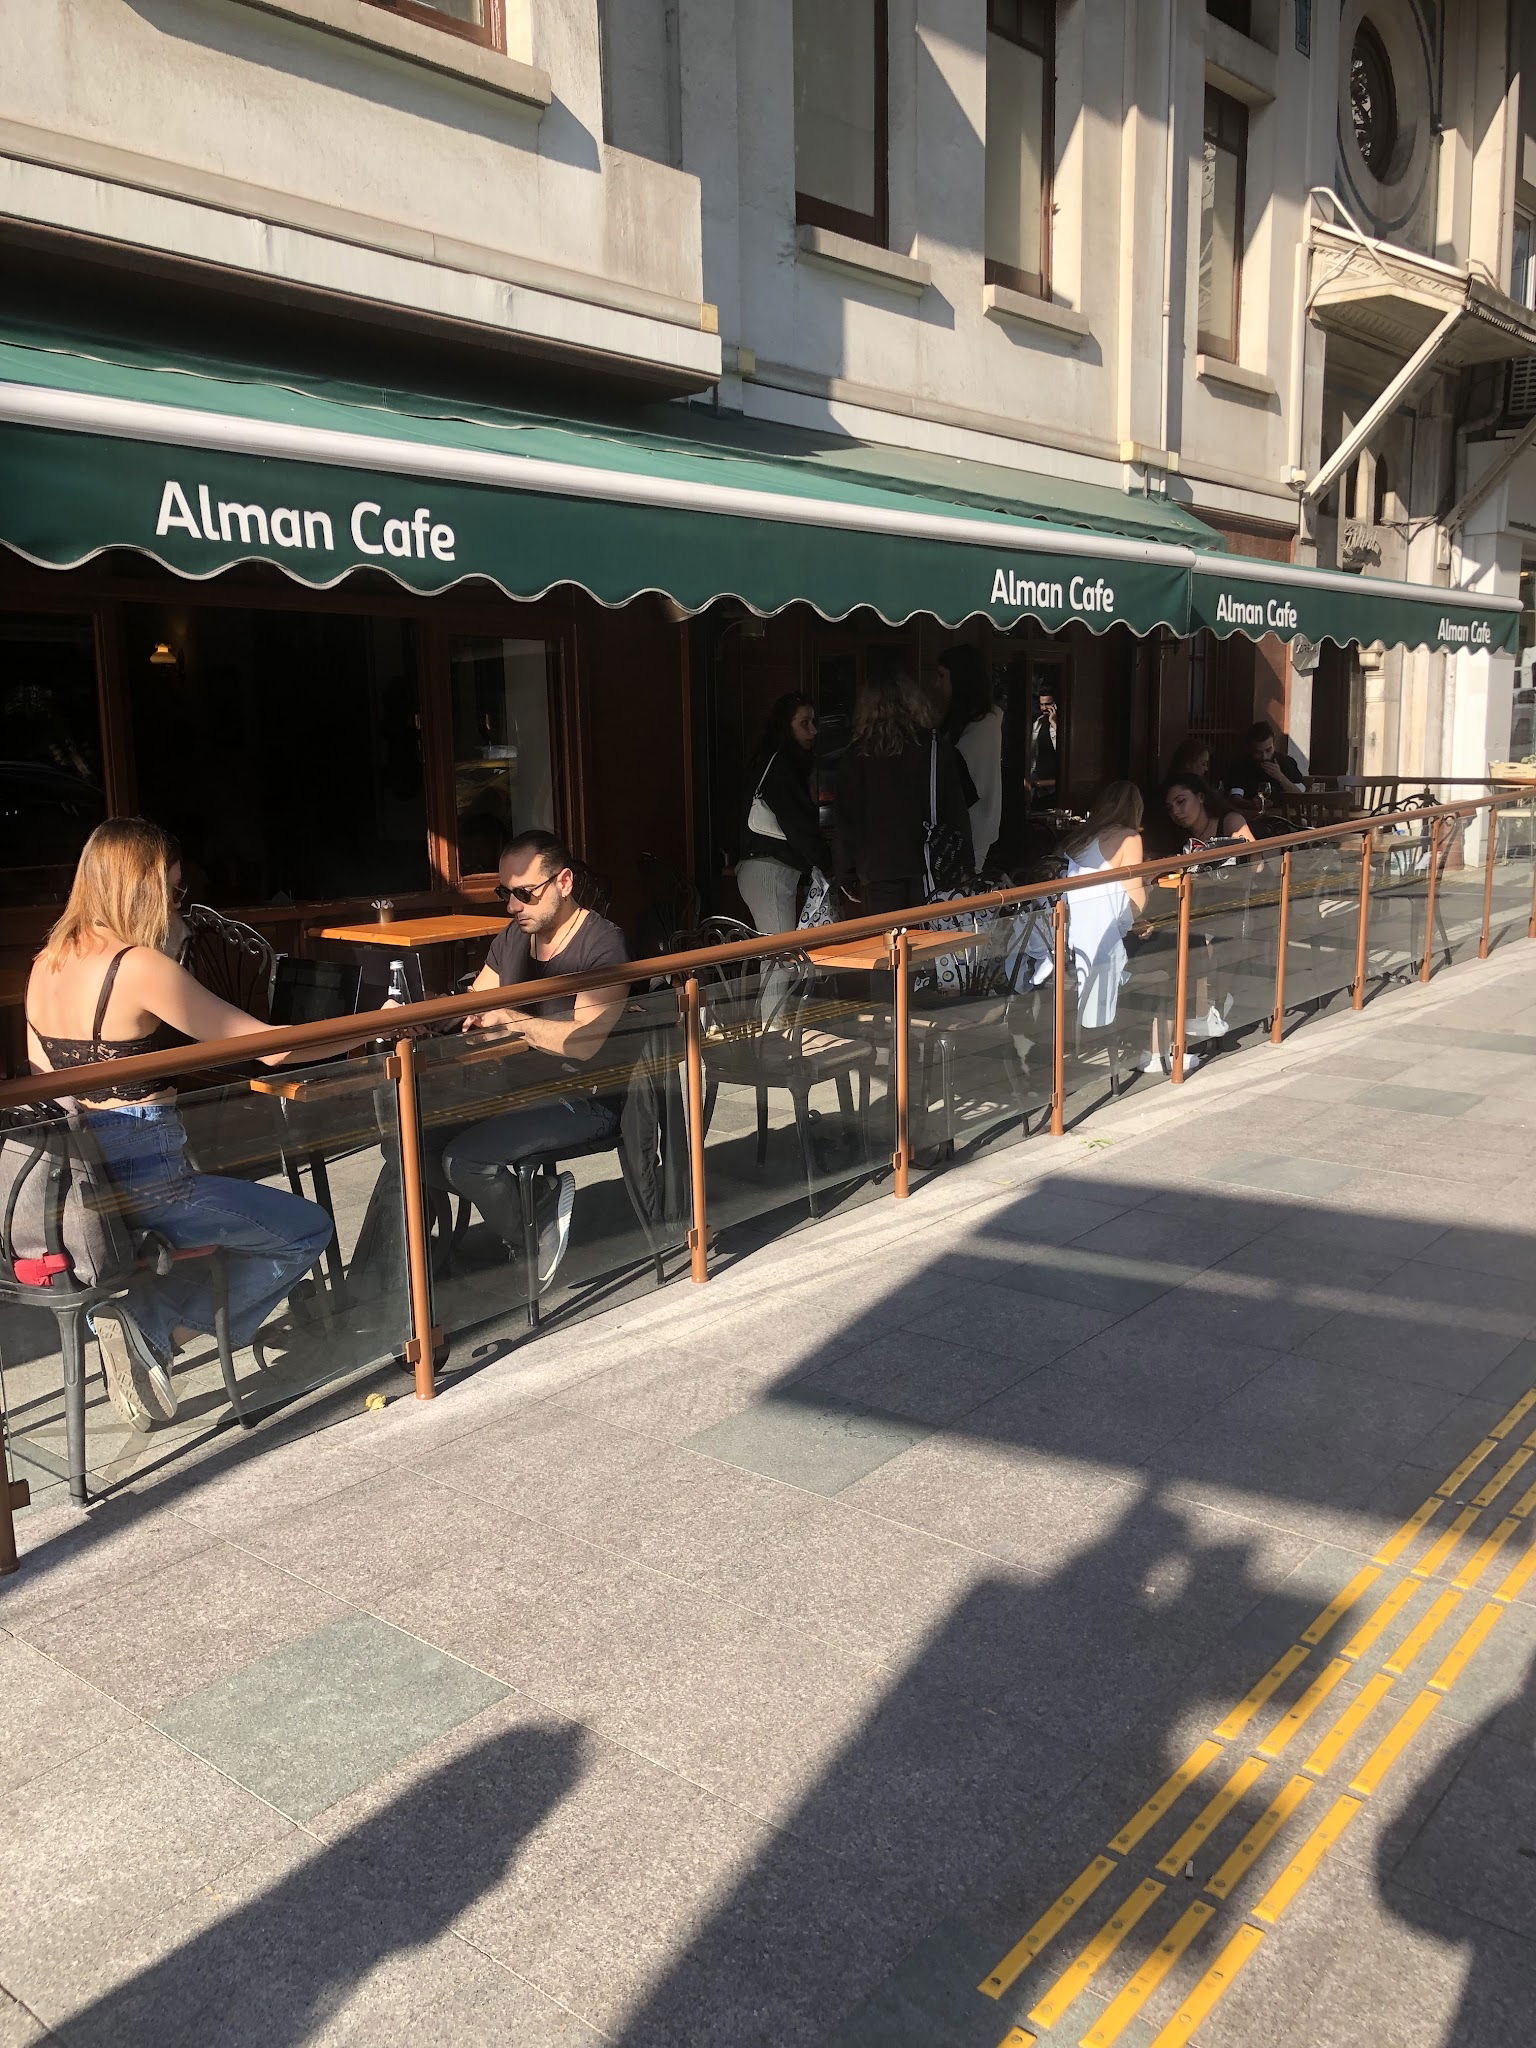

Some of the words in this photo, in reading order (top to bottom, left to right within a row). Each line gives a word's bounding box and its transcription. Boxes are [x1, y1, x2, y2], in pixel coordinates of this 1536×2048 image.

[155, 480, 335, 551] Alman
[350, 501, 456, 562] Cafe
[990, 568, 1063, 609] Alman
[1069, 576, 1115, 613] Cafe
[1216, 593, 1264, 625] Alman
[1266, 600, 1298, 629] Cafe
[1437, 617, 1469, 642] Alman
[1470, 620, 1492, 644] Cafe
